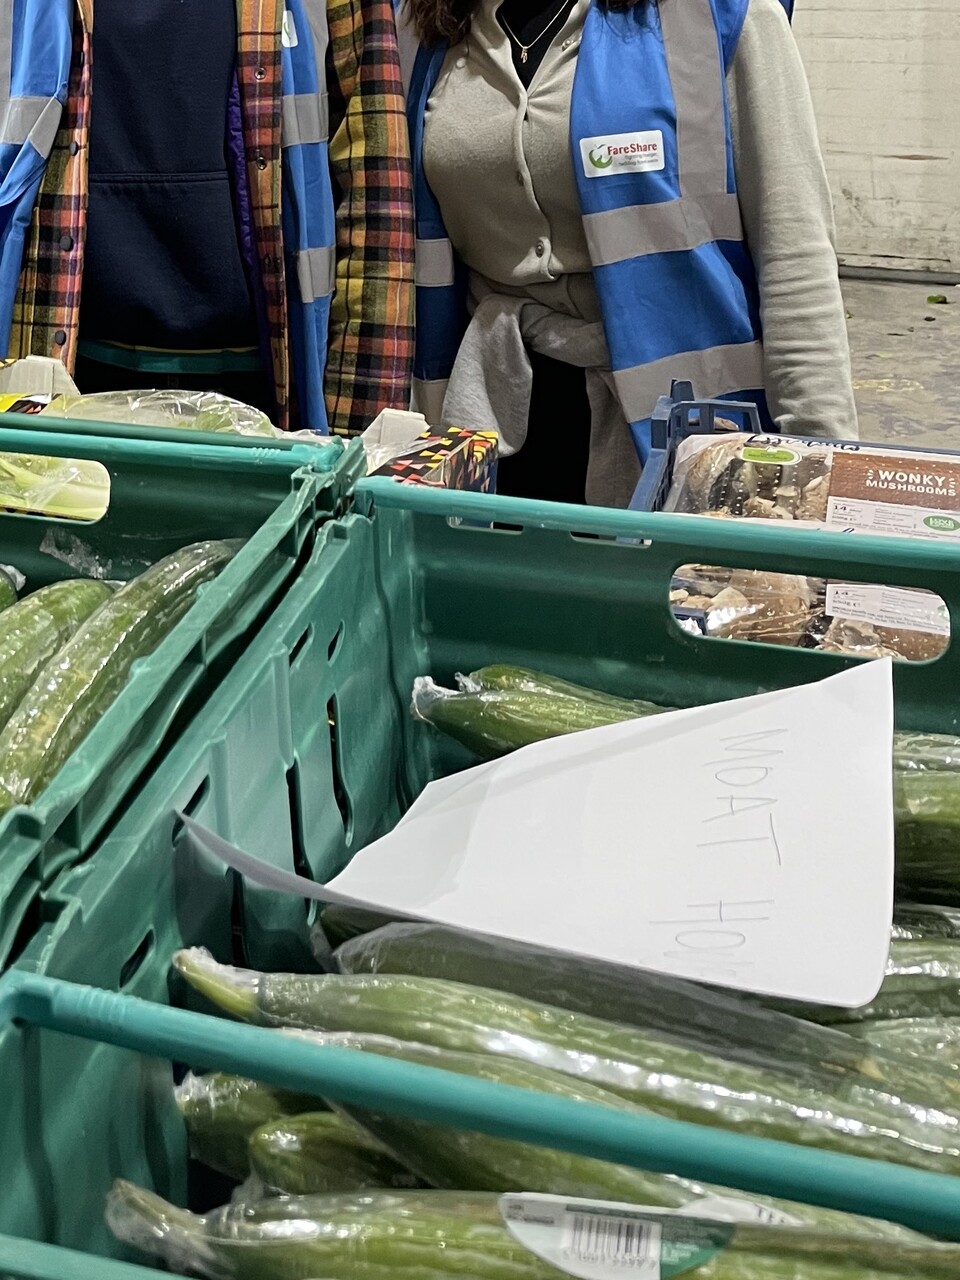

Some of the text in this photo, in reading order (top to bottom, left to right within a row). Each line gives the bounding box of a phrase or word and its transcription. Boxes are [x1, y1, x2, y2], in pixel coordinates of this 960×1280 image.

[607, 143, 658, 156] FareShare
[878, 469, 946, 487] WONKY
[865, 479, 957, 497] MUSHROOMS
[695, 728, 789, 866] MOAT
